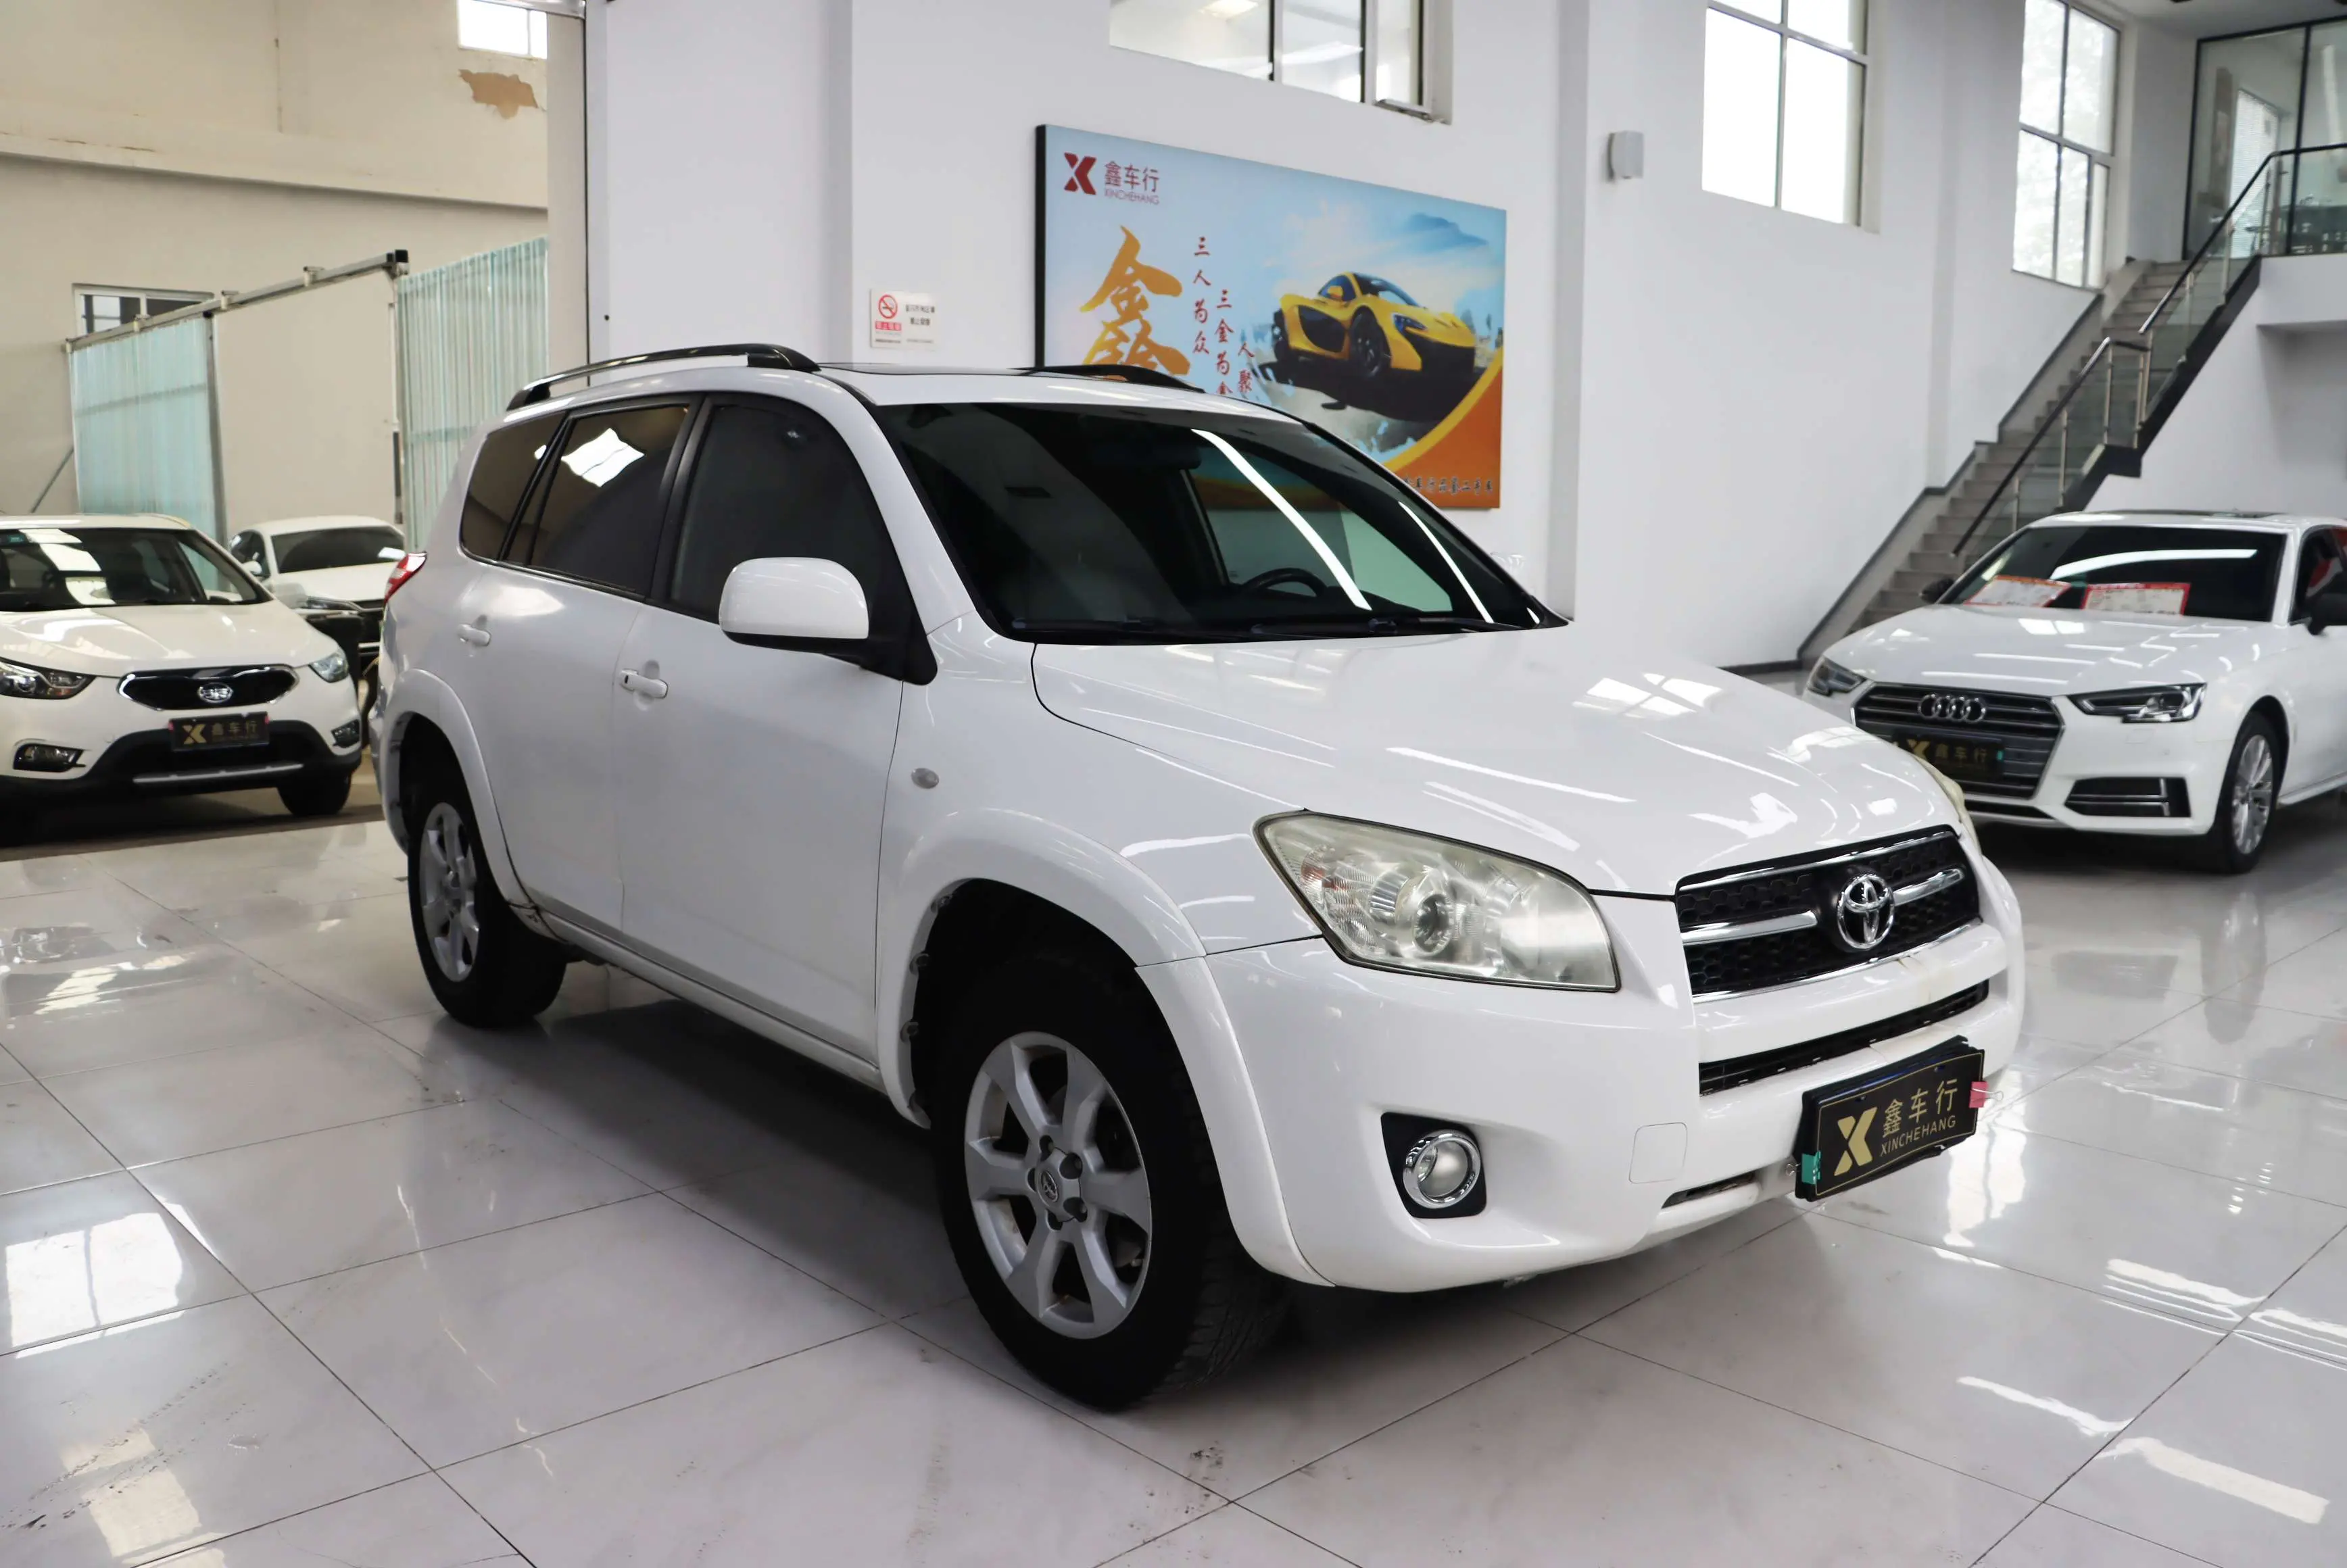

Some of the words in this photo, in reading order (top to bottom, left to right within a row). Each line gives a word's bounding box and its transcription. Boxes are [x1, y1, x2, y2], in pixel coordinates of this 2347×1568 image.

[1105, 161, 1159, 192] 鑫车行
[1192, 236, 1211, 354] 三人为众
[1883, 1079, 1958, 1138] 鑫车行
[1879, 1114, 1956, 1157] XINCHEHANG
